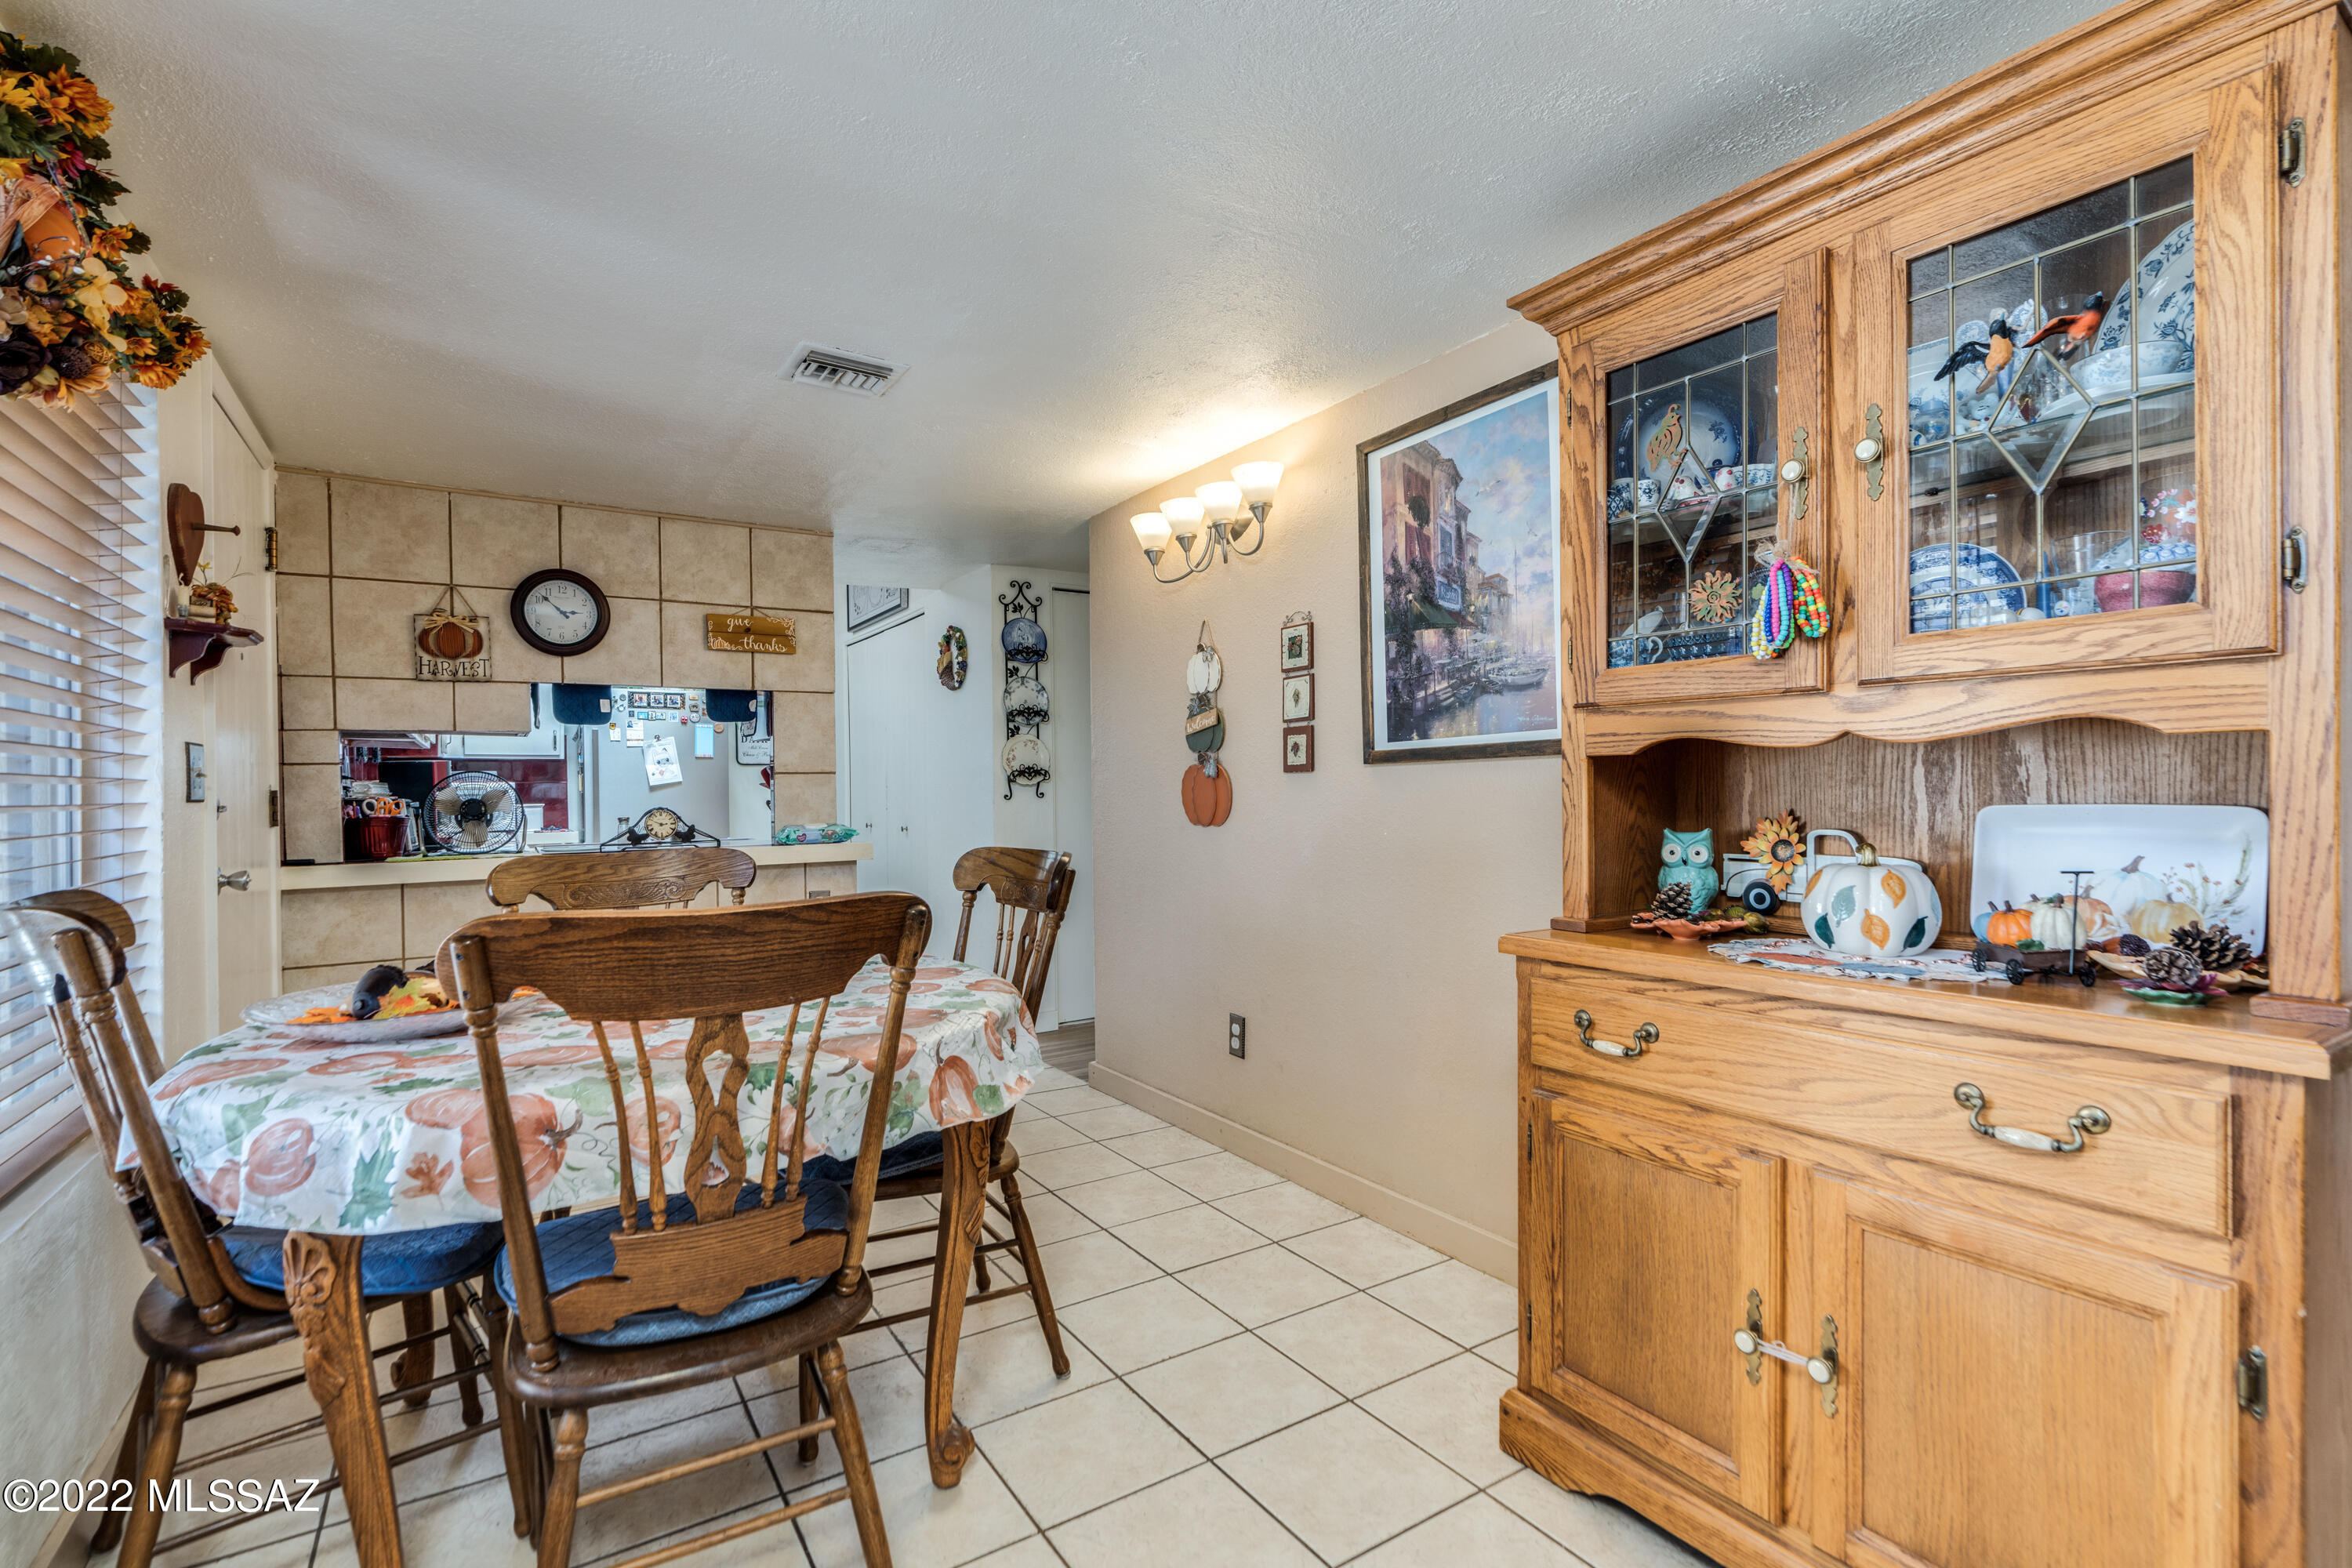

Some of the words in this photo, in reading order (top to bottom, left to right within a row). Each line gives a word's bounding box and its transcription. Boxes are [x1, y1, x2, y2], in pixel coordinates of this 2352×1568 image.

[573, 589, 576, 597] 1
[582, 597, 587, 607] 2
[727, 617, 753, 632] give
[547, 628, 552, 637] 7
[739, 635, 787, 652] thanks
[418, 655, 490, 677] HARVEST
[1187, 715, 1216, 733] Welcome
